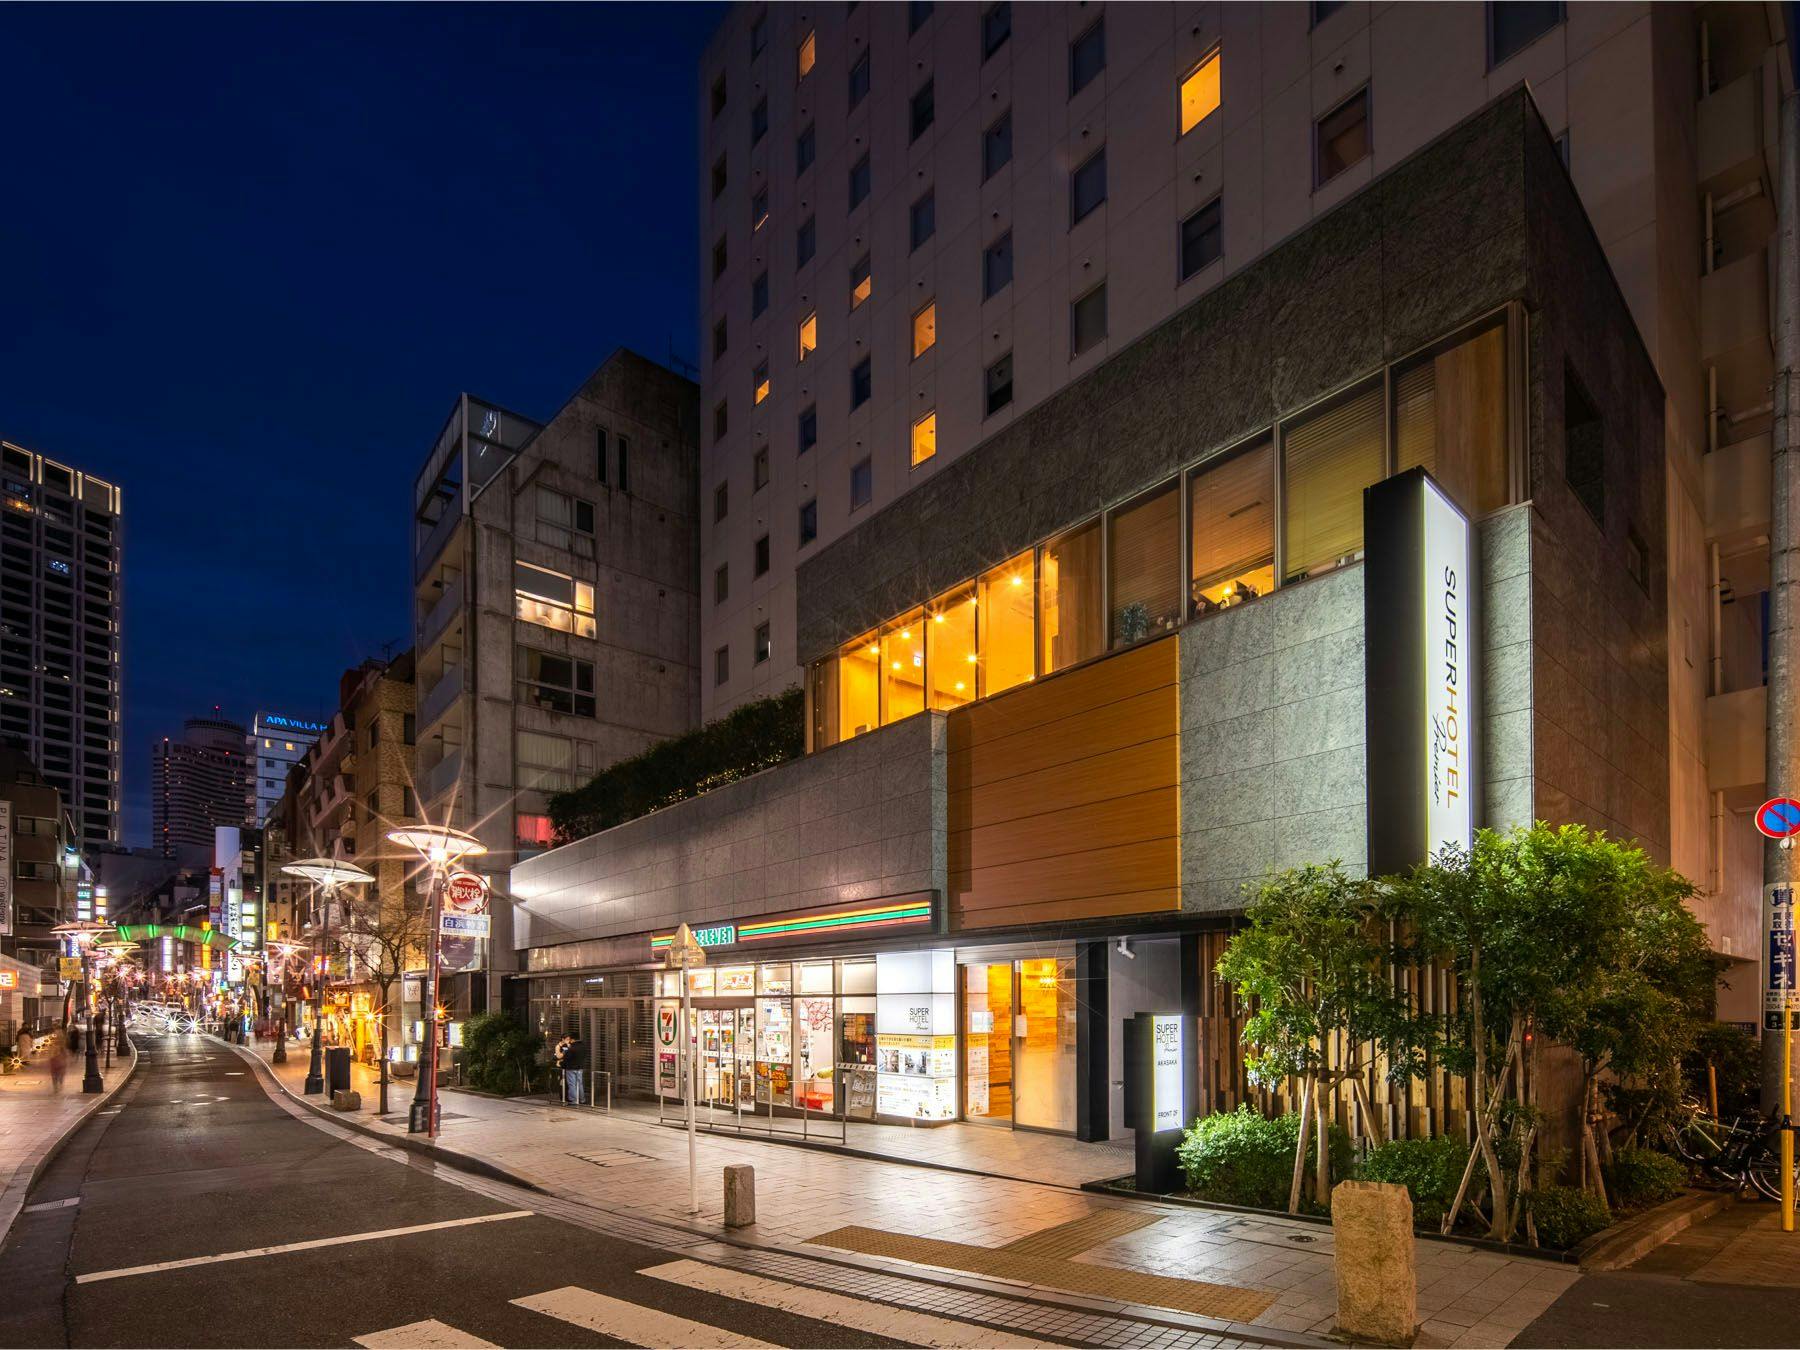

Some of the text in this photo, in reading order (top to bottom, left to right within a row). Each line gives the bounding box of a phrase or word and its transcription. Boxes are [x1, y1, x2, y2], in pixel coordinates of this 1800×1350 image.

[266, 716, 287, 726] APA
[289, 719, 318, 731] VILLA
[1432, 712, 1448, 806] Premier
[451, 886, 480, 899] 消火栓
[909, 1008, 930, 1016] SUPER
[909, 1015, 929, 1024] HOTEL
[1156, 1023, 1178, 1033] SUPER
[1156, 1033, 1178, 1043] HOTEL
[1158, 1110, 1172, 1118] FRONT
